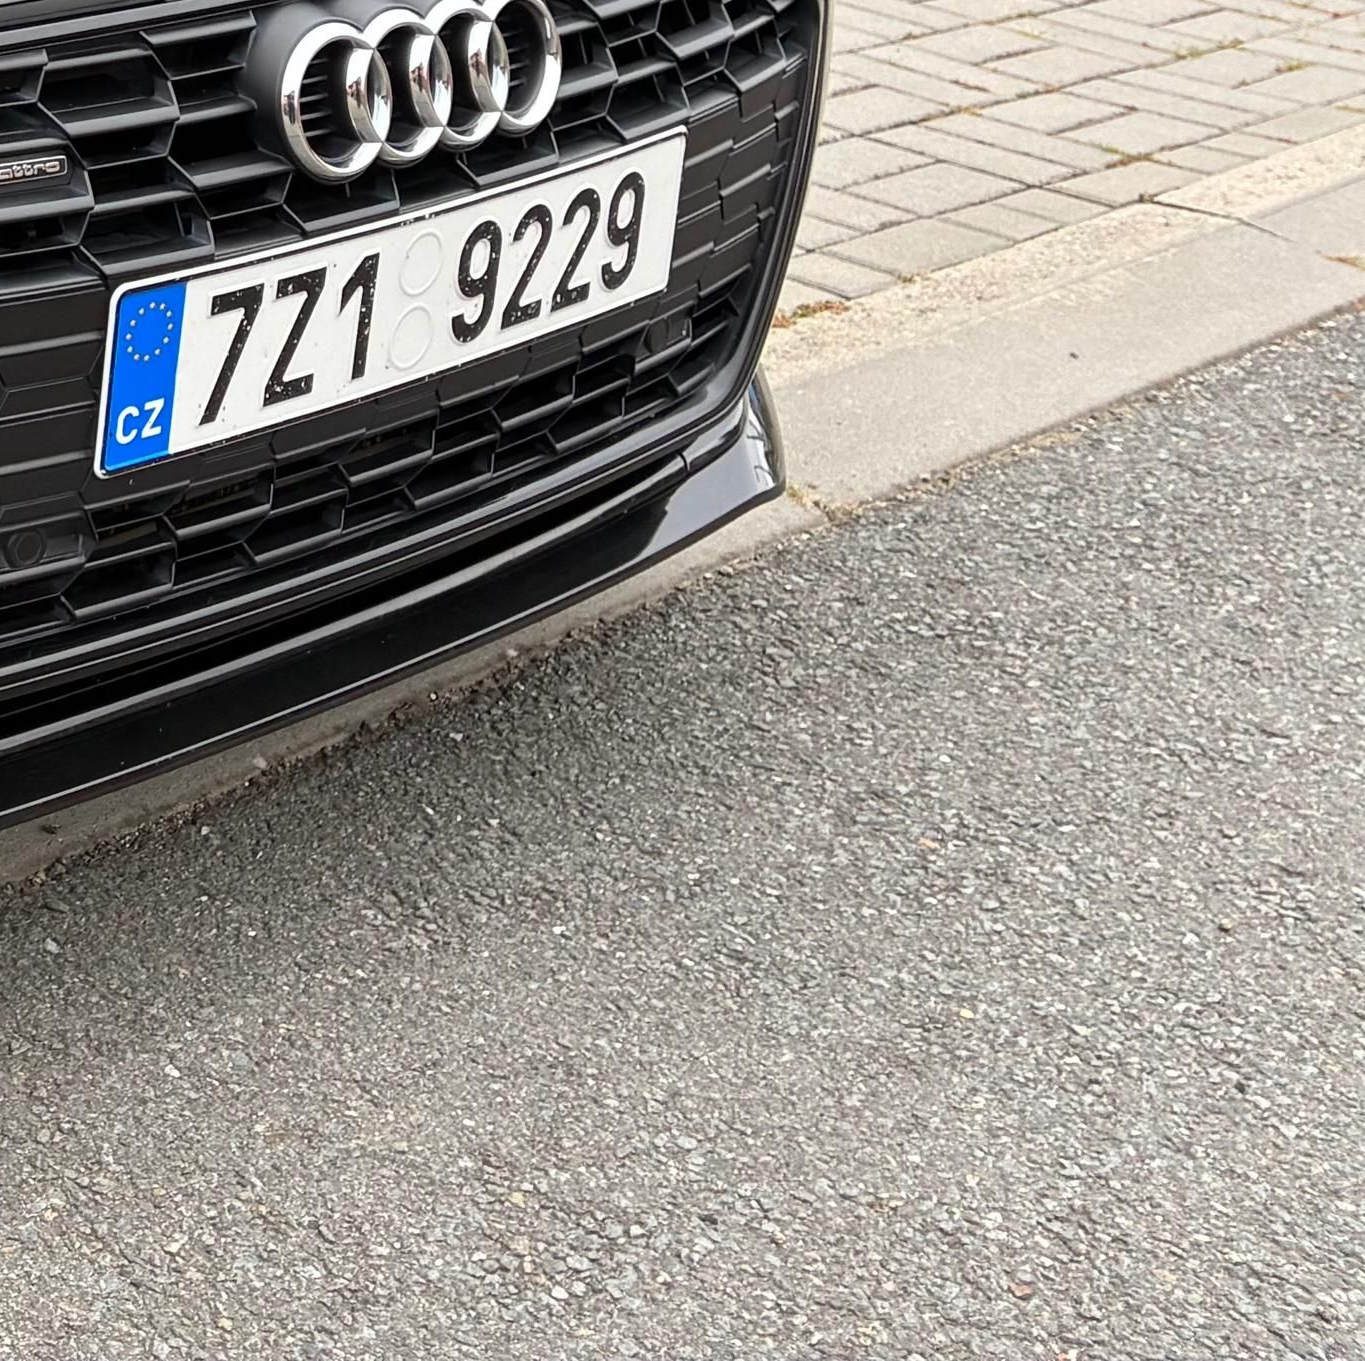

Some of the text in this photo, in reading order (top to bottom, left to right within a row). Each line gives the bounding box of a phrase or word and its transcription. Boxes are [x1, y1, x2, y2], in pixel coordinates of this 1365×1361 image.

[198, 171, 646, 426] 7Z1 9229
[116, 398, 163, 444] CZ
